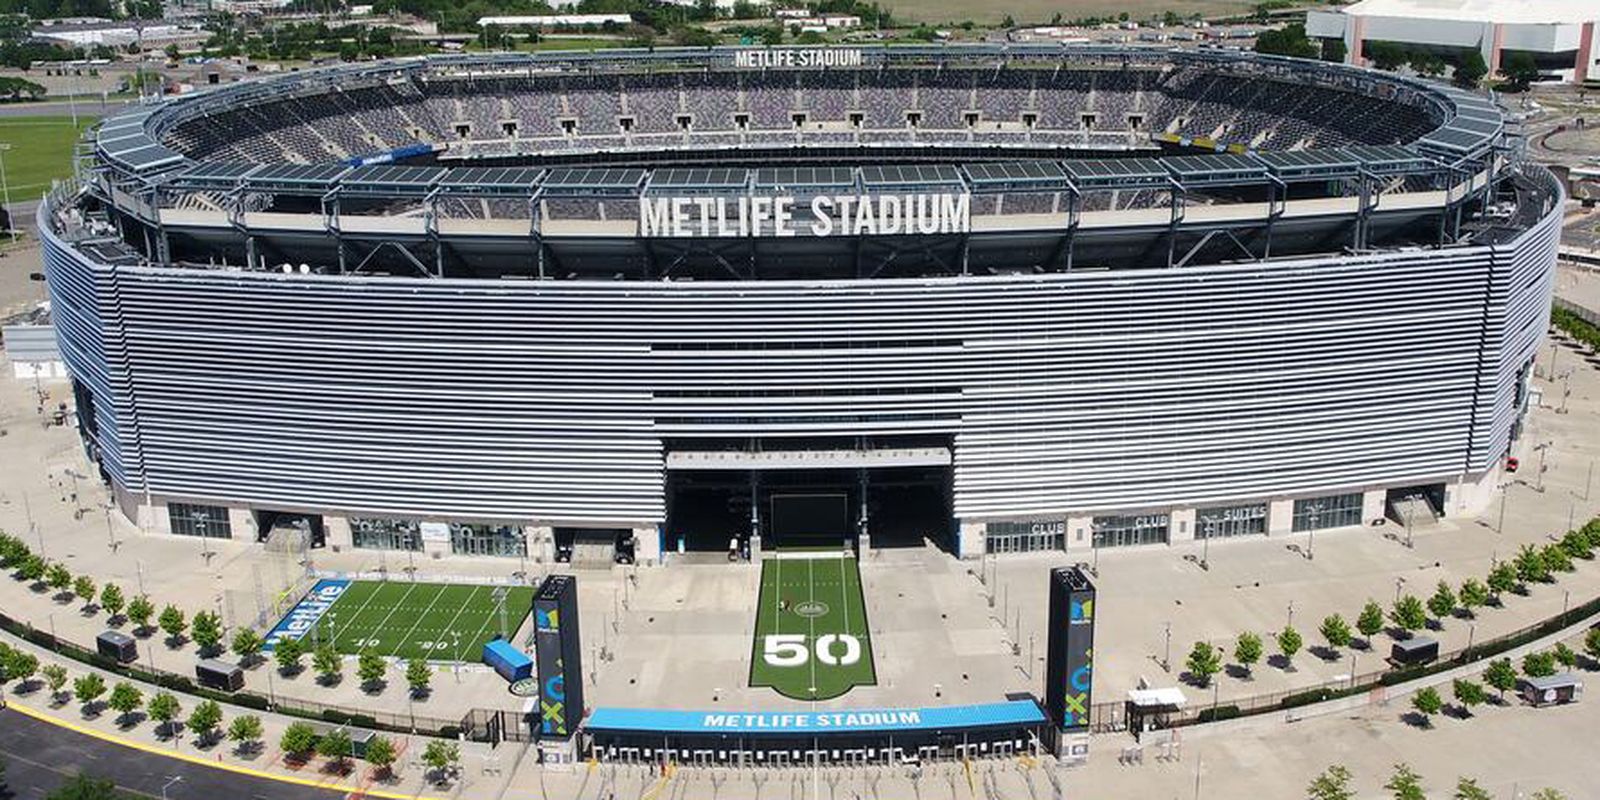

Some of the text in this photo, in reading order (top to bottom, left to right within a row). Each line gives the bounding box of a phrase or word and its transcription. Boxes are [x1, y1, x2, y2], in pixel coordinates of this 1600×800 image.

[736, 49, 861, 67] METLIFE STADIUM
[640, 193, 971, 237] METLIFE STADIUM
[1223, 506, 1267, 519] SUITES
[1031, 522, 1065, 535] CLUB
[1135, 516, 1168, 528] CLUB
[763, 634, 861, 667] 50
[703, 711, 921, 727] METLIFE STADIUM
